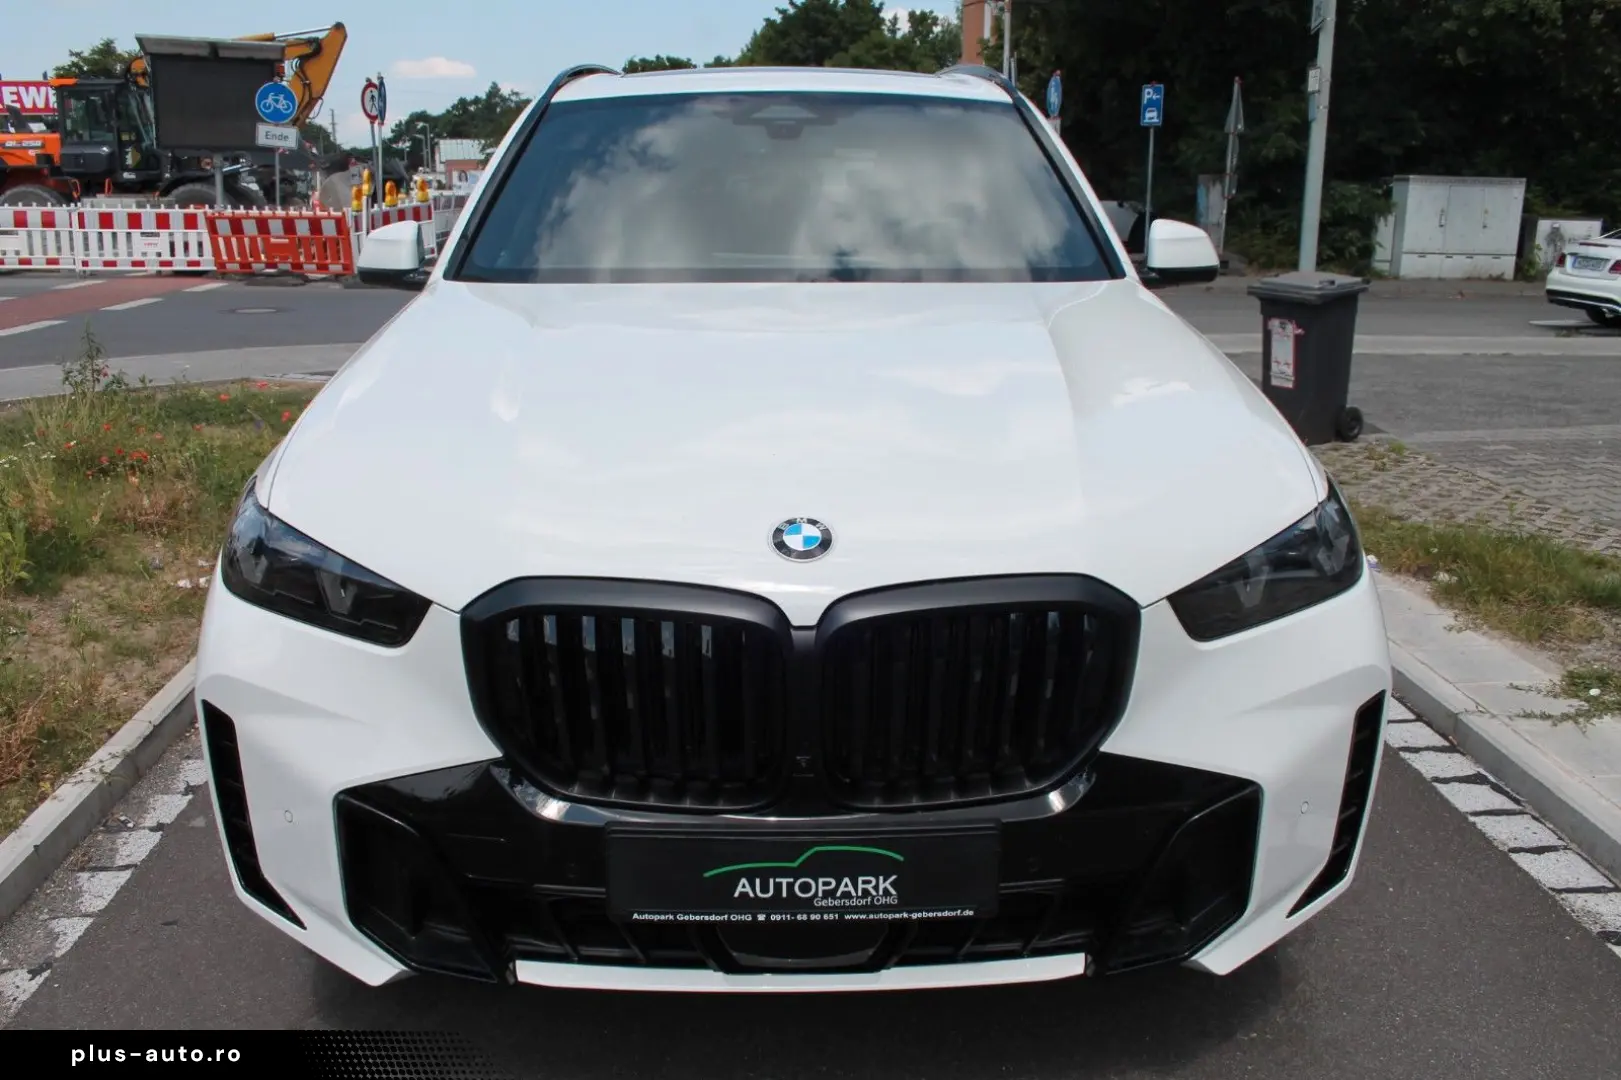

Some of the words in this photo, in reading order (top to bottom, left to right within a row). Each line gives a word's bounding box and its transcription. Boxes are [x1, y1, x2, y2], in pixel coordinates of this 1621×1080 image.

[0, 86, 57, 109] EW
[1144, 88, 1153, 104] P
[265, 131, 289, 141] Ende
[778, 518, 828, 530] BMW
[733, 875, 898, 898] AUTOPARK
[813, 897, 872, 907] Gebersdorf
[873, 896, 898, 905] OHG
[632, 912, 675, 922] Autopark
[676, 913, 728, 921] Gebersdorf
[844, 909, 974, 920] www.autopark-gebersdorf.de
